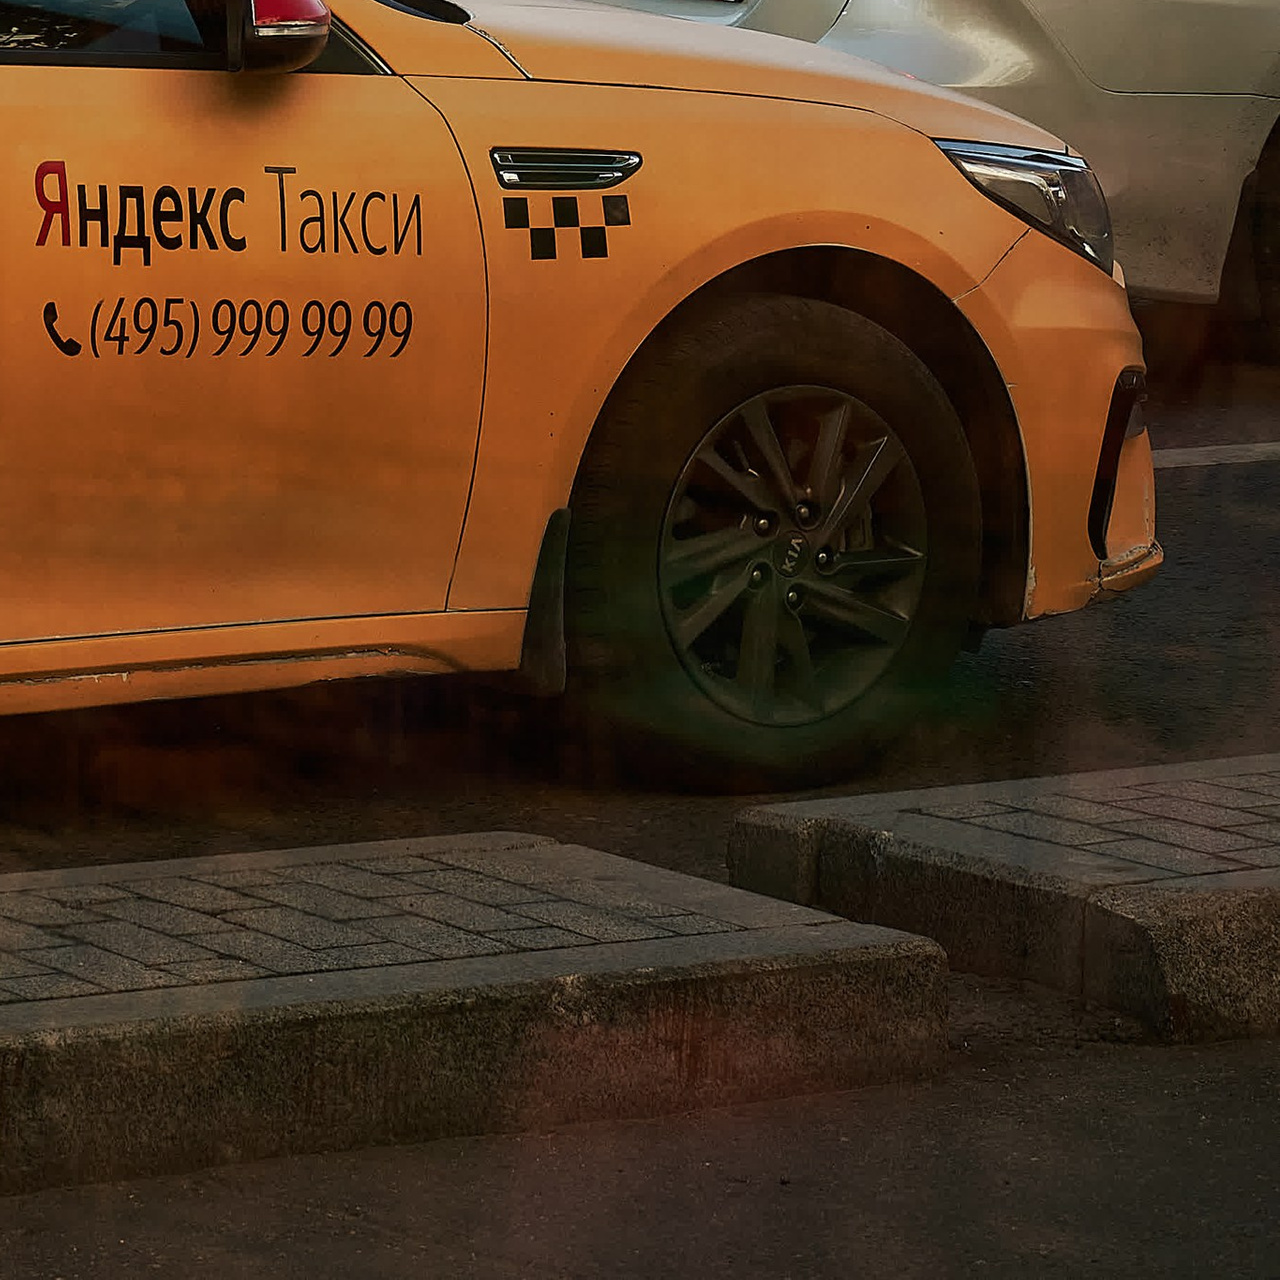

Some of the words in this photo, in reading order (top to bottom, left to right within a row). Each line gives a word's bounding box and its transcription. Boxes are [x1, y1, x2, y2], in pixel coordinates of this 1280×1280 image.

[34, 160, 247, 267] Яндекс
[264, 166, 422, 256] Такси
[89, 297, 201, 358] (495)
[211, 299, 290, 358] 999
[301, 300, 352, 358] 99
[362, 300, 413, 358] 99
[782, 539, 803, 572] KIA
